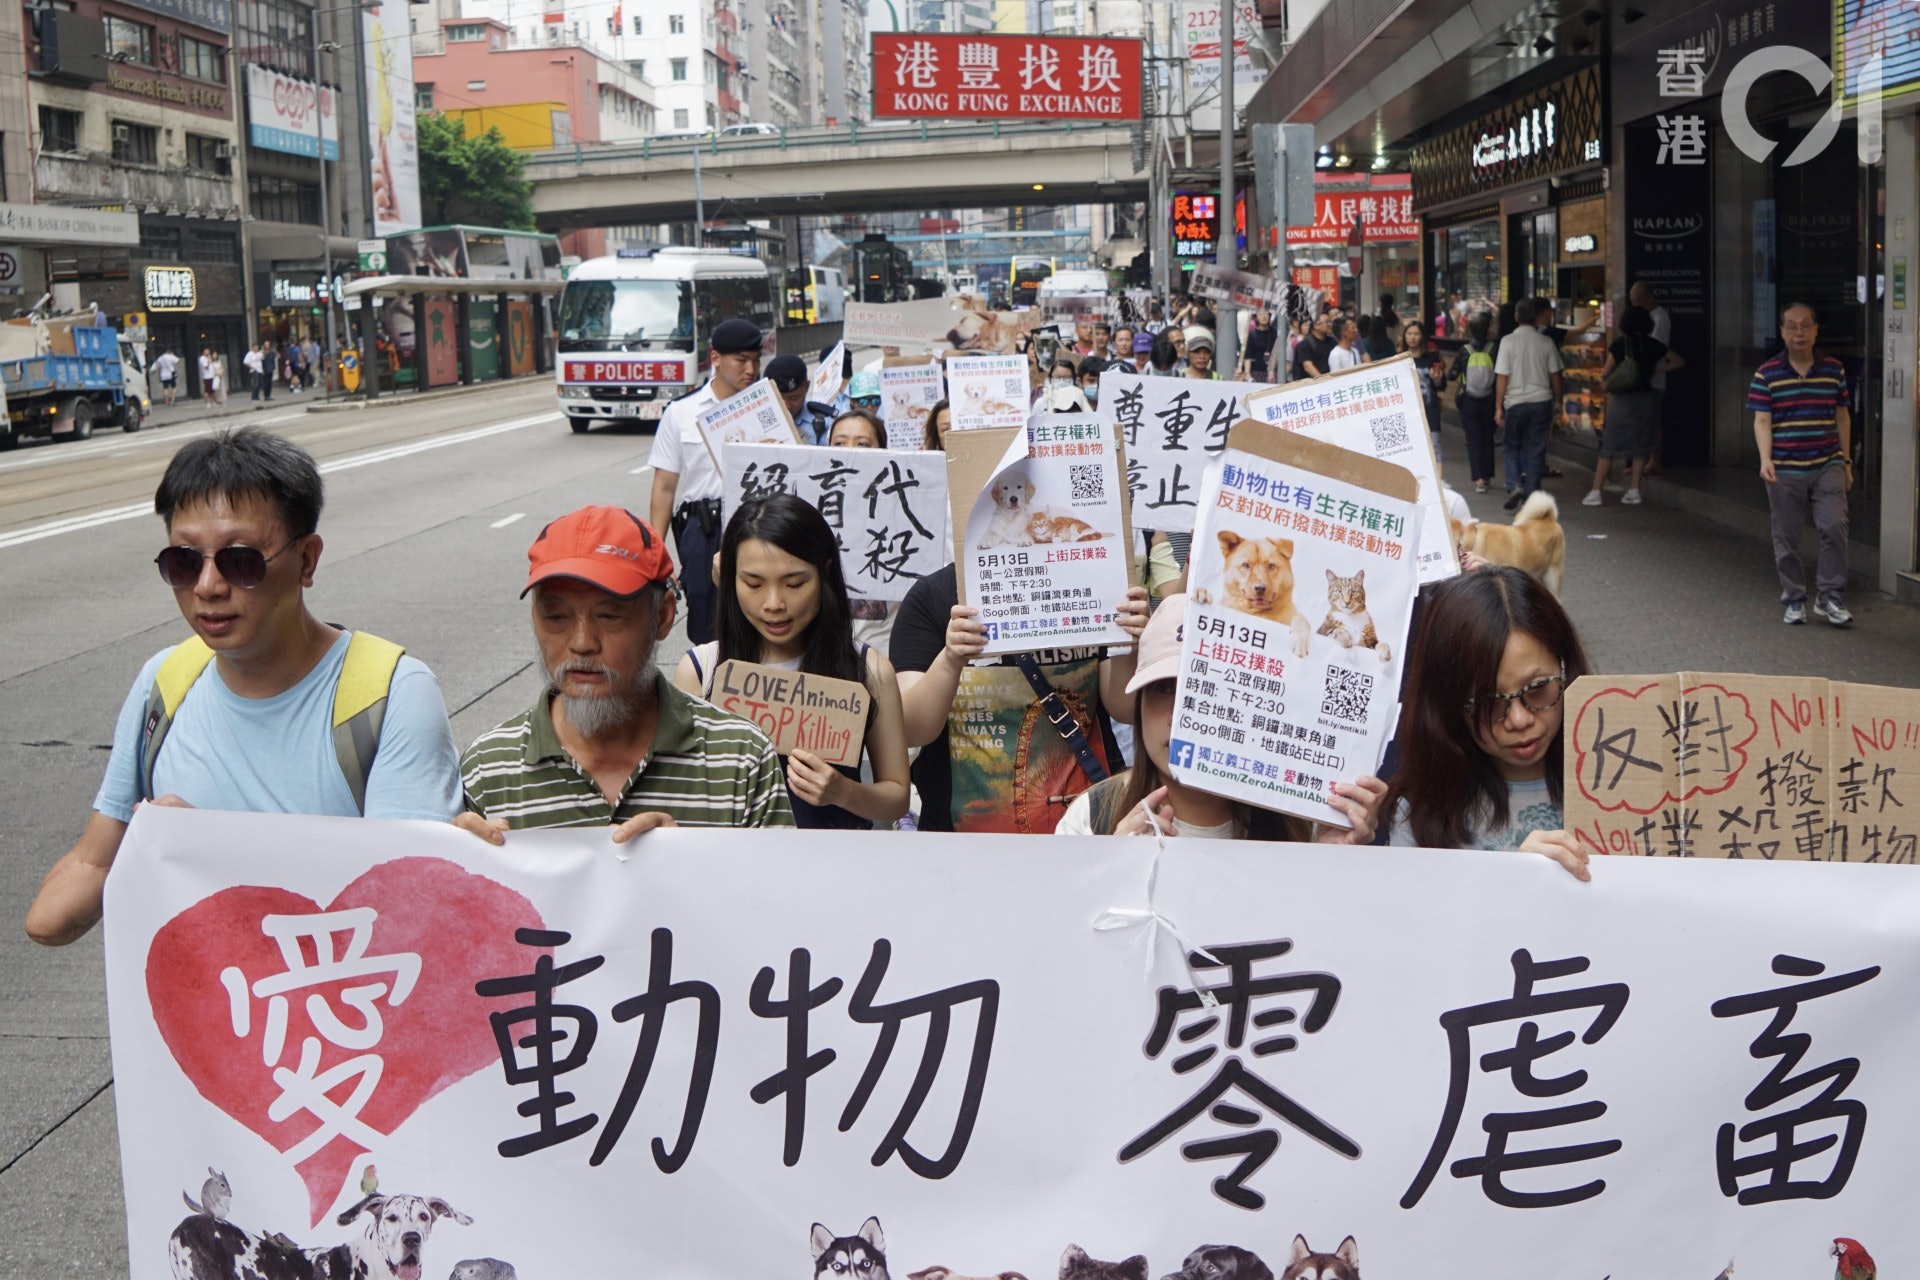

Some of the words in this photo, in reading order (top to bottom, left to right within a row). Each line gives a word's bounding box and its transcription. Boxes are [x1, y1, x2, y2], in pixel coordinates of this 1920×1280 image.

[1187, 10, 1222, 28] 212
[894, 40, 1122, 93] 港豐找換
[894, 93, 949, 111] KONG
[957, 93, 1009, 111] FUNG
[1019, 94, 1122, 114] EXCHANGE
[1174, 195, 1193, 220] 民
[1313, 194, 1419, 227] 人民幣找換
[1633, 217, 1695, 229] KAPLAN
[1286, 228, 1308, 239] ONG
[1311, 227, 1337, 239] FUNG
[1365, 225, 1419, 237] EXCHANGE
[572, 363, 586, 380] 警
[594, 363, 655, 380] POLICE
[662, 364, 677, 380] 察
[705, 387, 766, 424] 動物也有生存權利
[1266, 375, 1400, 421] 動物也有生存權利
[1270, 393, 1404, 431] 對政府撥款撲殺動物
[1222, 464, 1405, 538] 動物也有生存權利
[1217, 490, 1402, 560] 反對政府撥款撲殺動物
[978, 553, 1029, 567] 5月13日
[979, 565, 1049, 580] (周一公眾假期)
[1044, 547, 1107, 564] 上街反撲殺
[980, 583, 1004, 593] 時間:
[1008, 579, 1052, 591] 下午2:30
[982, 593, 1026, 605] 集合地點:
[1031, 588, 1092, 601] 銅鑼灣東角道
[1000, 618, 1058, 631] 獨立義工發起
[1062, 616, 1090, 626] 愛動物
[1001, 626, 1107, 640] fb.com/ZeroAnimalAbuse
[1196, 615, 1267, 649] 5月13日
[1192, 638, 1285, 678] 上街反撲殺
[722, 662, 788, 702] LOVE
[790, 674, 861, 715] Animals
[1185, 677, 1219, 698] 時間:
[1227, 688, 1285, 715] 下午2:30
[1190, 658, 1286, 697] (周一公眾假期)
[796, 709, 851, 762] Killing
[948, 712, 994, 722] PASSES
[1182, 696, 1243, 724] 集合地點:
[1251, 714, 1337, 750] 銅鑼灣東角道
[1317, 717, 1367, 737] bit.ly/antikill
[1771, 692, 1840, 749] NO!!
[1851, 718, 1920, 757] NO!!
[1592, 695, 1733, 791] 反對
[1196, 762, 1329, 805] fb.com/ZeroAnimalAbu
[1198, 746, 1279, 780] 獨立義工發起
[1284, 769, 1323, 791] 愛動物
[1757, 750, 1904, 813] 撥款
[1634, 806, 1918, 864] 撲殺動物
[220, 905, 1001, 1180] 愛動物
[1116, 937, 1881, 1211] 零虐畜
